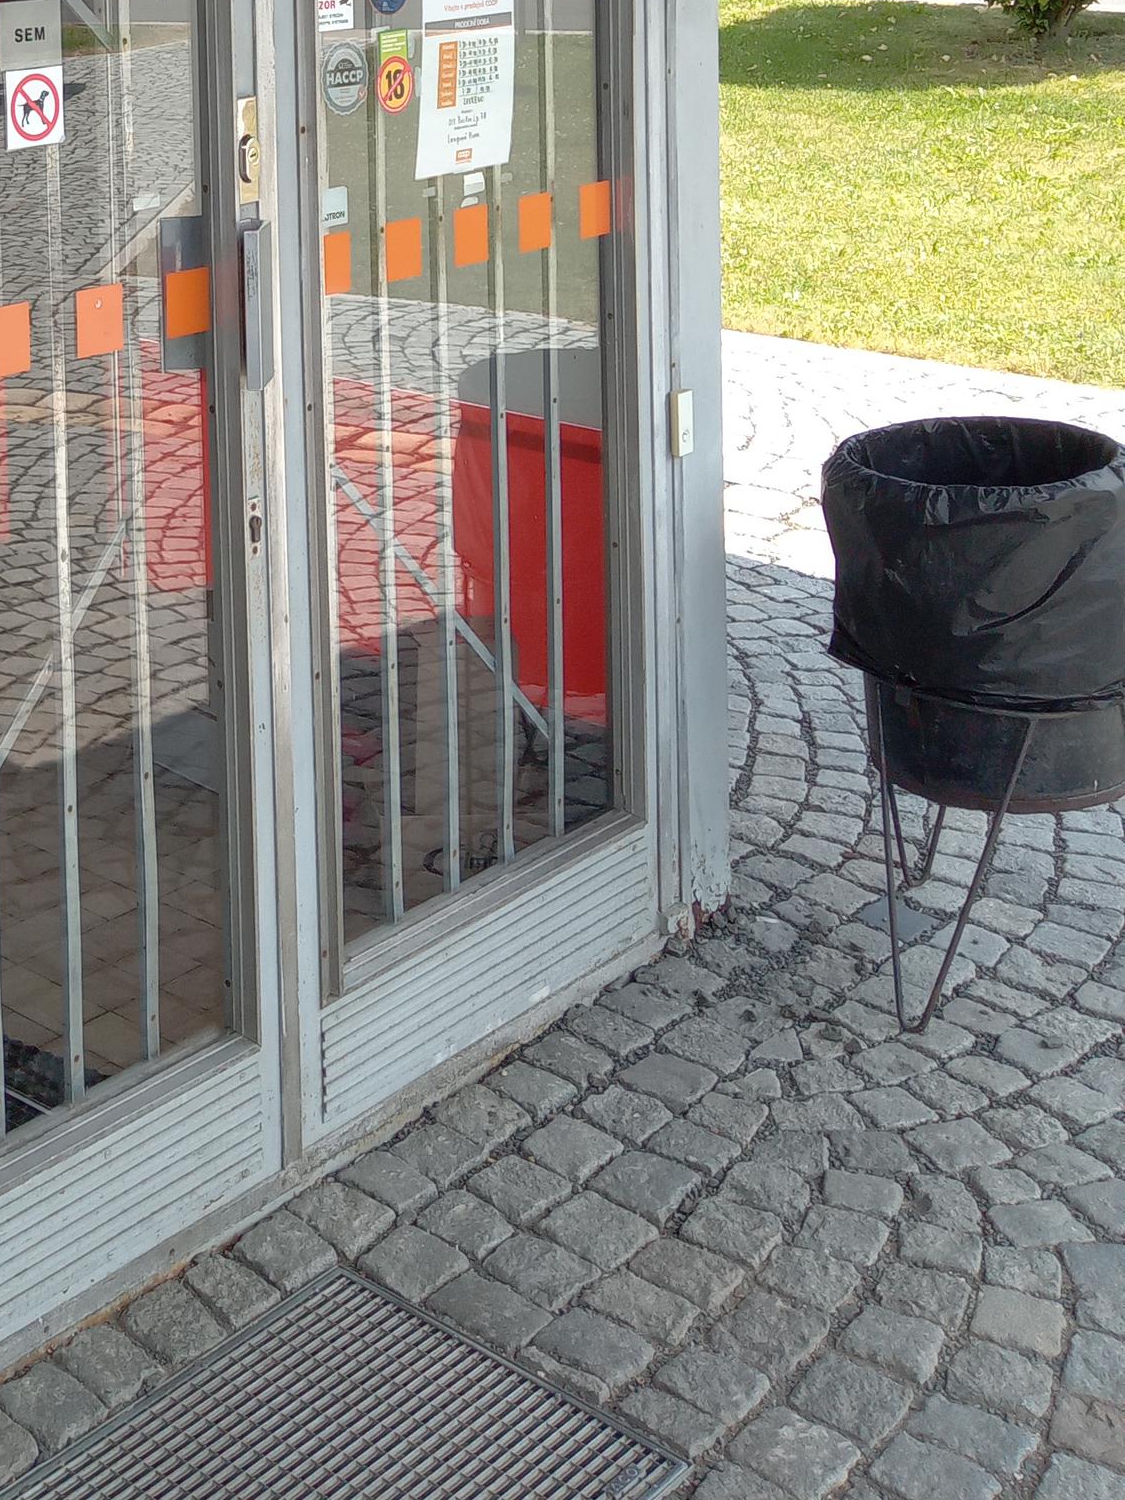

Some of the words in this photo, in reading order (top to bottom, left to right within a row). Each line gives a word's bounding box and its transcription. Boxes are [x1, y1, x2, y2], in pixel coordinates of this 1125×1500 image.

[14, 26, 46, 43] SEM
[325, 68, 364, 86] HACCP
[385, 68, 405, 102] 18
